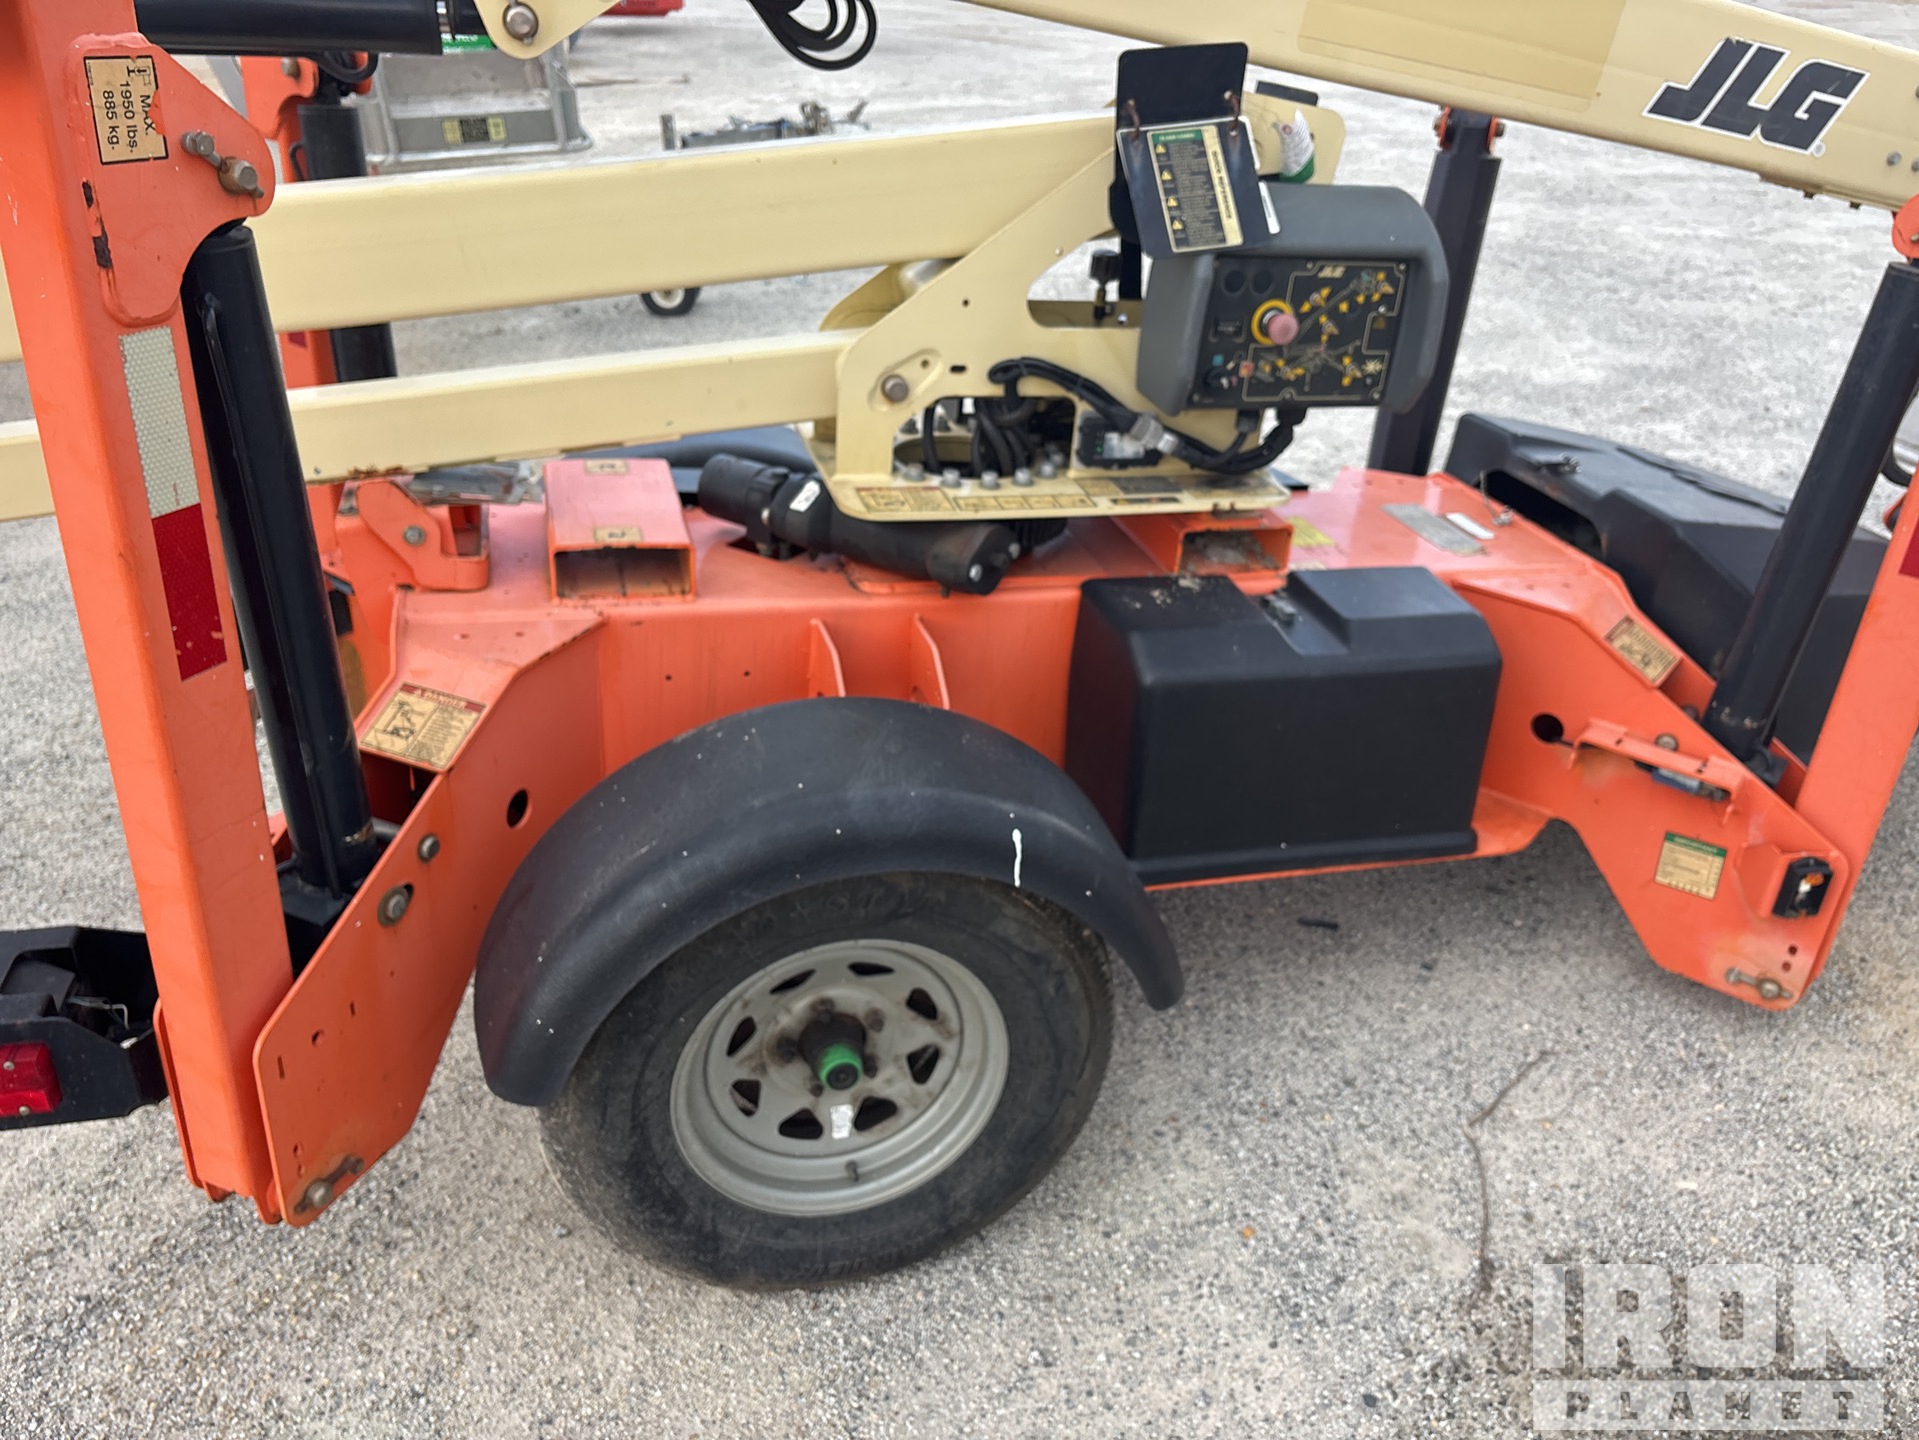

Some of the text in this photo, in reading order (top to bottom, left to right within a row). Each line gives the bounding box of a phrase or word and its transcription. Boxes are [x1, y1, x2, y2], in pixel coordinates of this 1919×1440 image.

[103, 90, 119, 150] 885 kg.
[120, 80, 138, 153] 1950 lbs.
[1643, 36, 1870, 154] JLG
